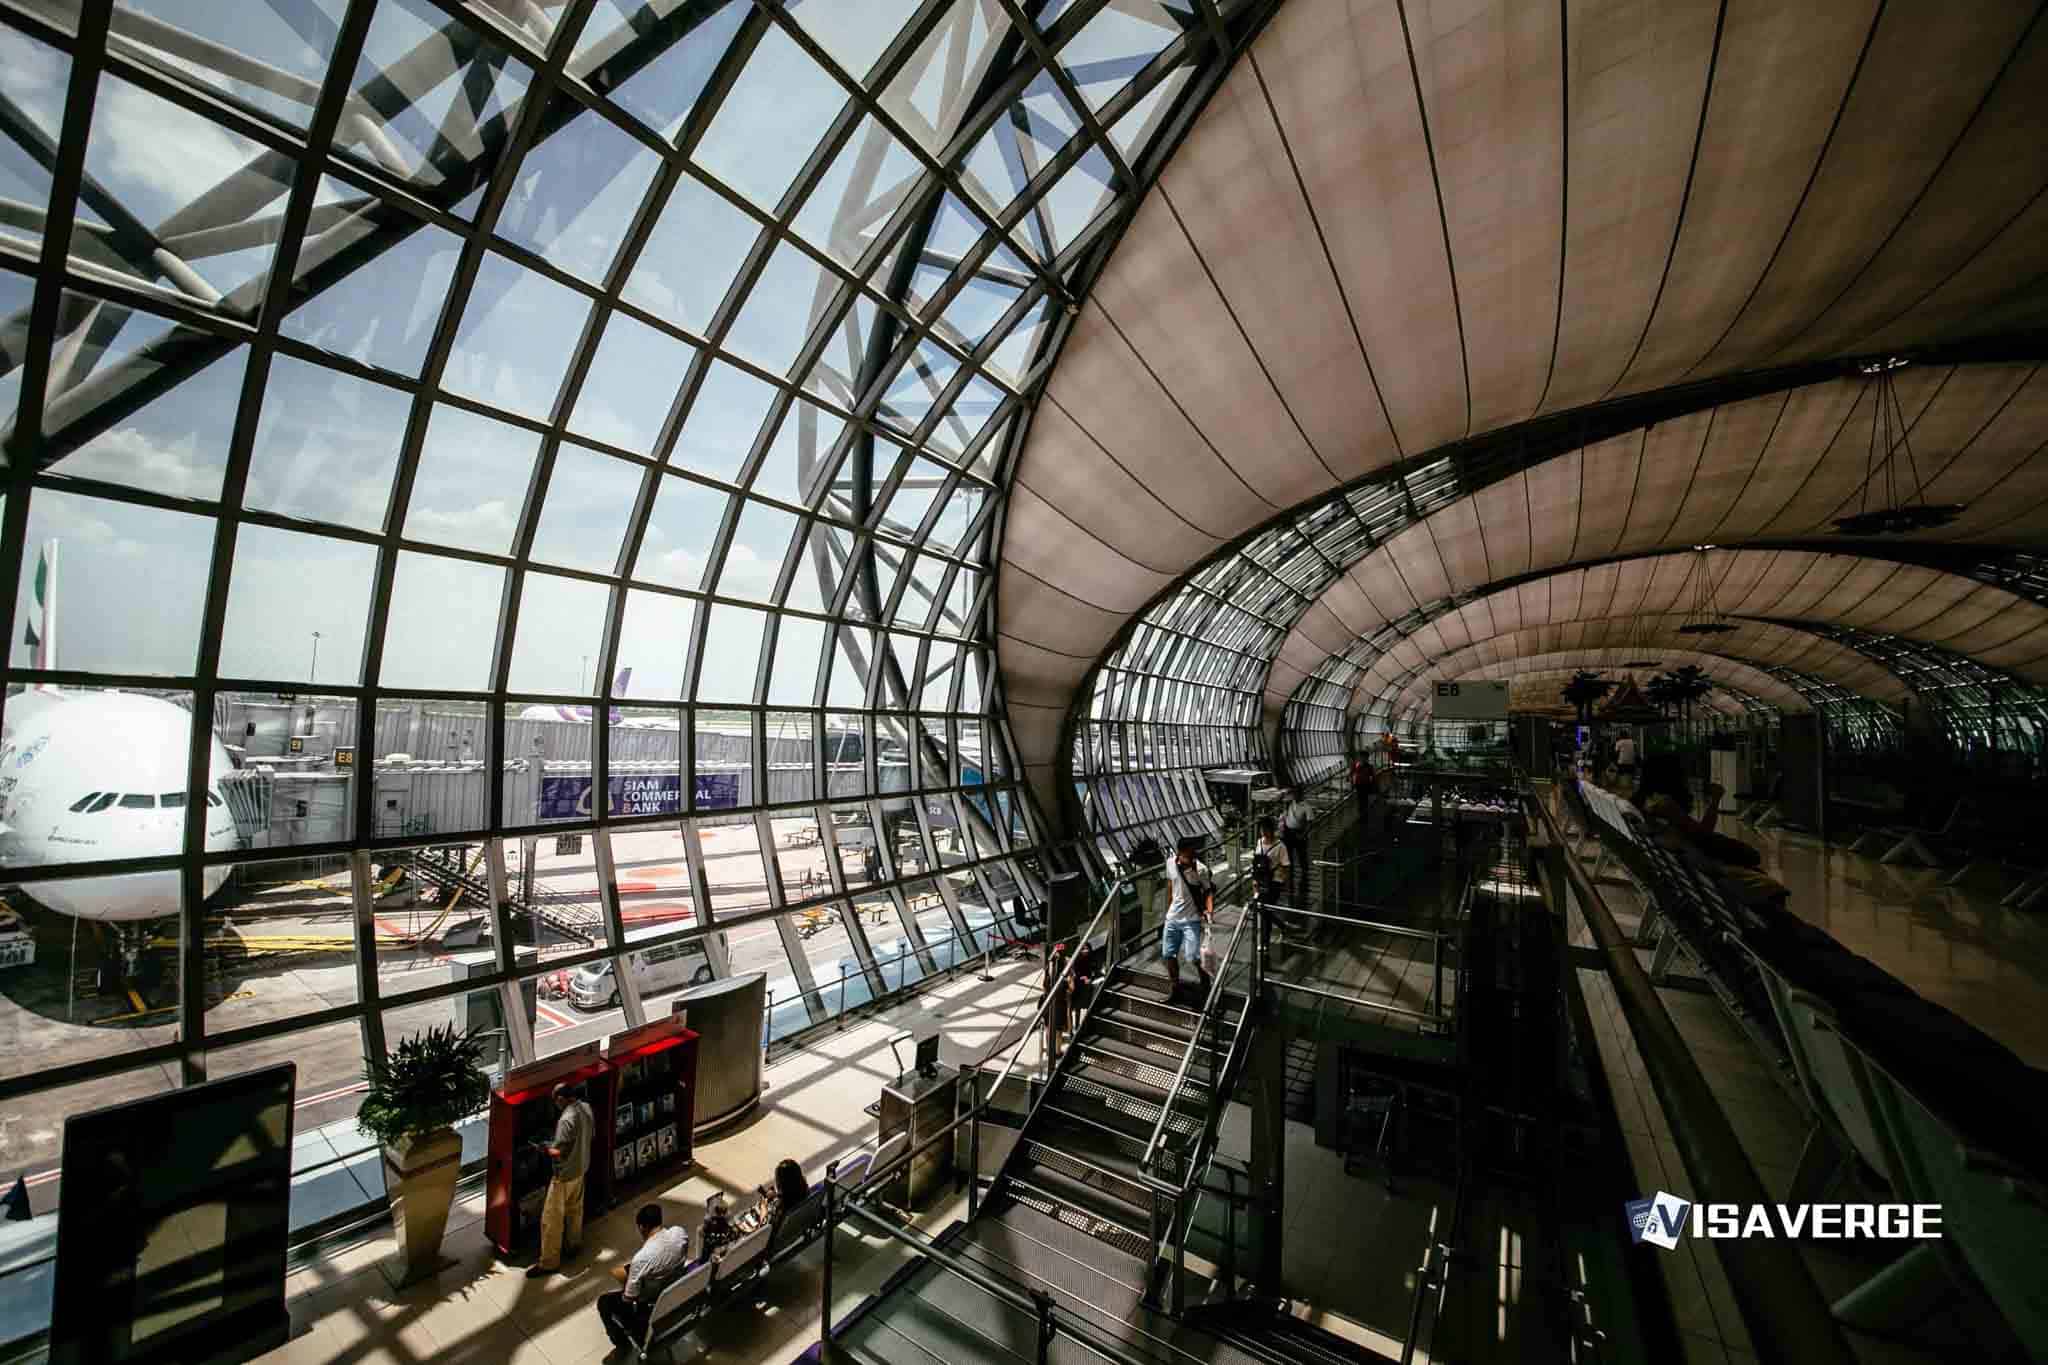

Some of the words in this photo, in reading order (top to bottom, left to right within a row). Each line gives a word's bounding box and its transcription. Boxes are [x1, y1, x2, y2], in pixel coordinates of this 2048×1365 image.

[338, 752, 353, 763] E8
[624, 779, 659, 791] SIAM
[624, 801, 661, 813] BANK
